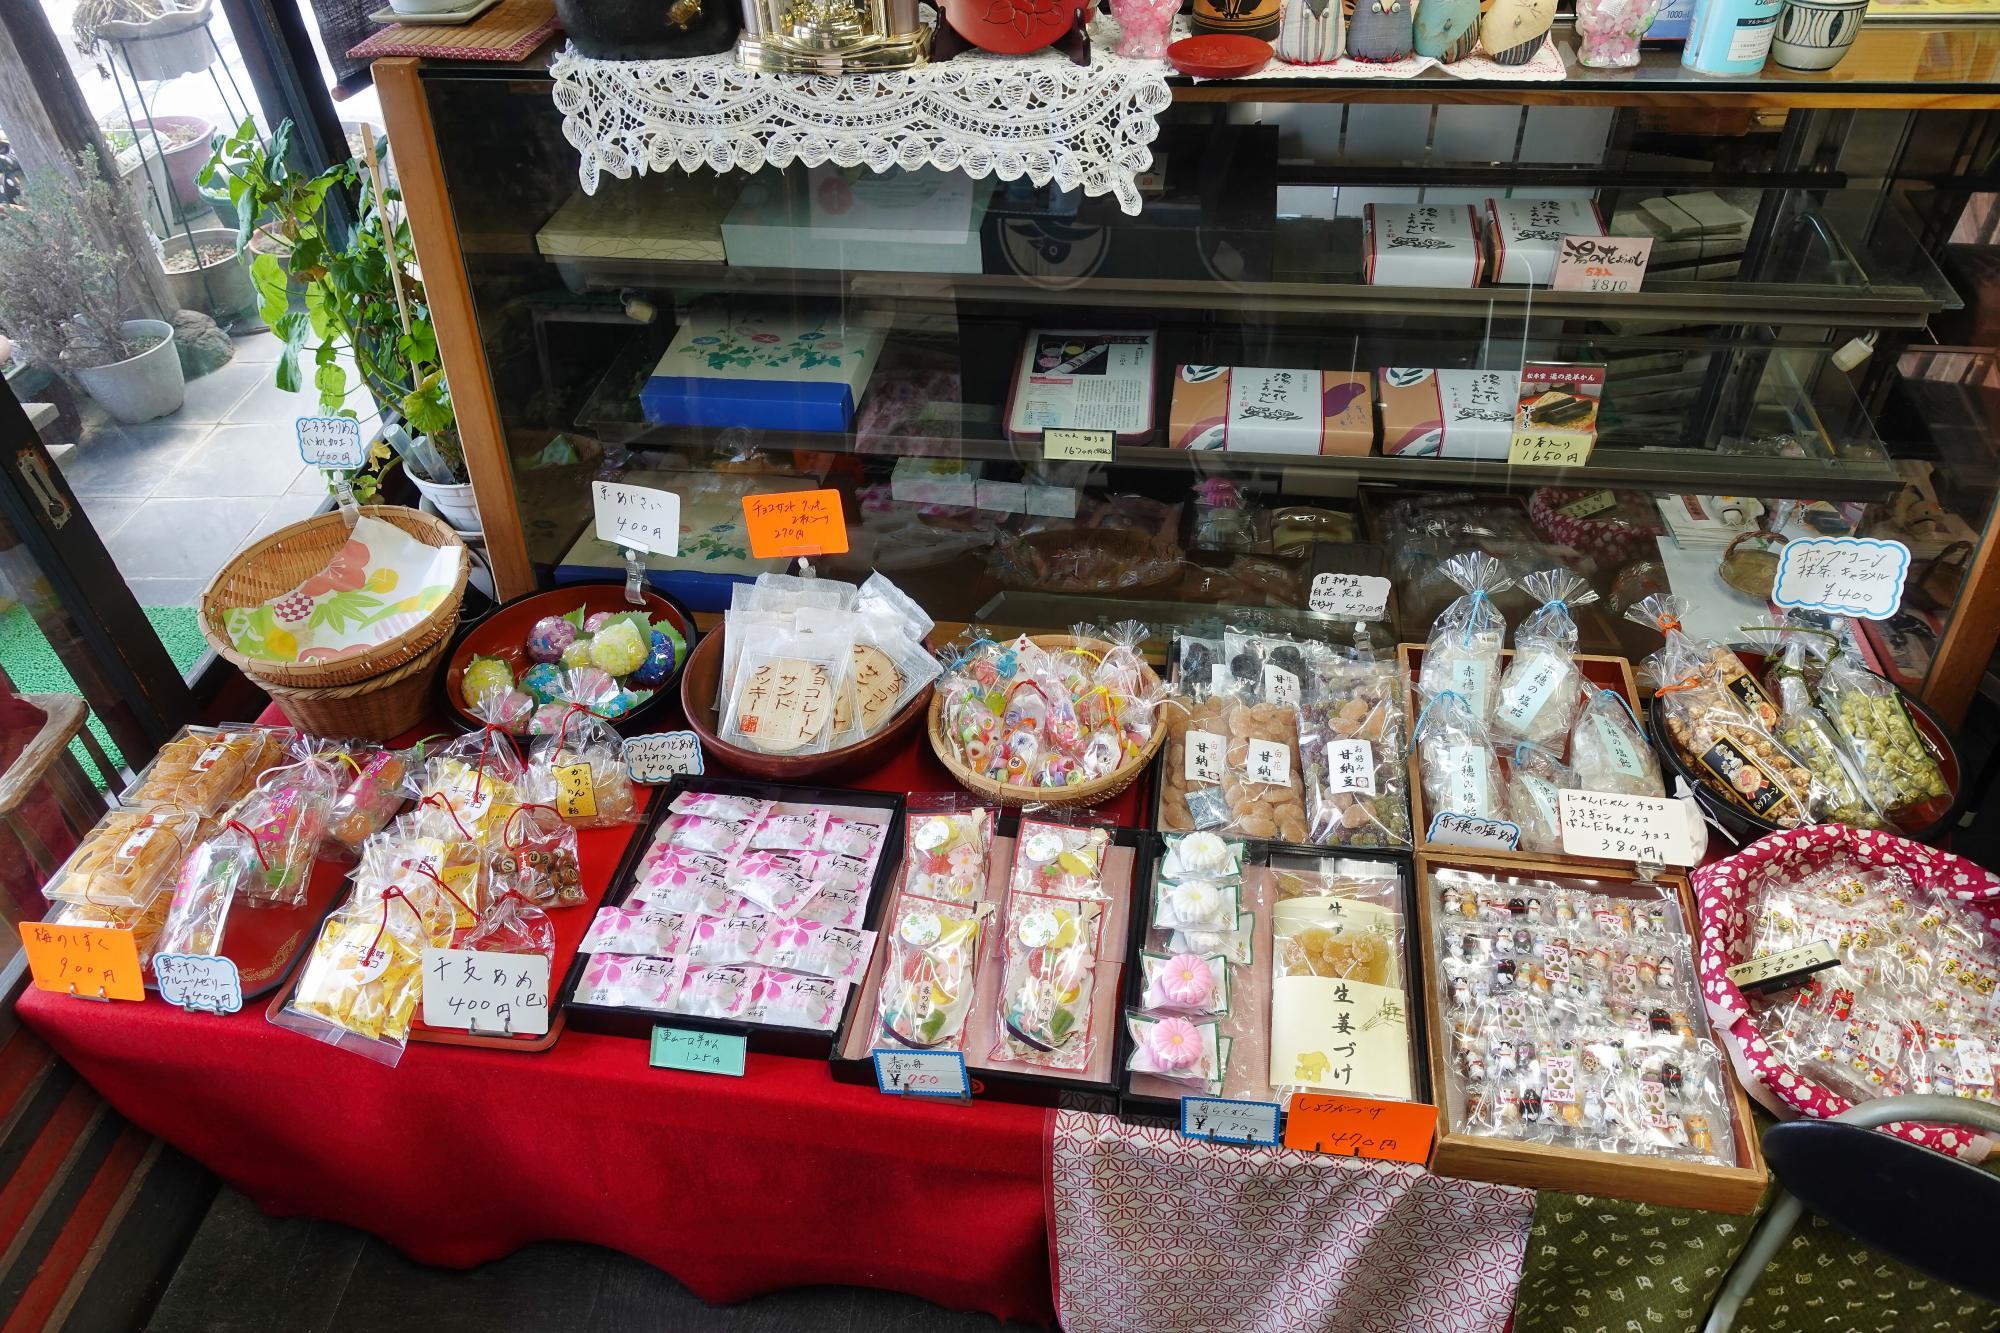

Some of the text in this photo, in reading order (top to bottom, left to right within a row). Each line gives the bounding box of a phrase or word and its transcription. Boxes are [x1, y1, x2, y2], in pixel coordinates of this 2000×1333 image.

[1591, 279, 1628, 292] ¥810
[1515, 437, 1570, 449] 10本入り
[316, 450, 350, 465] 400円
[1523, 451, 1578, 462] 1650円
[617, 516, 661, 539] 400円
[1797, 548, 1888, 568] ポップコーン
[1320, 575, 1362, 588] 甘納豆
[1820, 582, 1873, 603] ¥400
[1345, 603, 1383, 613] 470円
[748, 665, 771, 711] クッキー
[776, 675, 798, 709] サンド
[800, 664, 828, 738] チョコレート
[628, 737, 697, 753] かりんのどあめ
[1195, 742, 1209, 778] 甘納豆
[1355, 746, 1365, 772] お好み
[646, 763, 688, 774] 400円
[1339, 749, 1357, 788] 甘納豆
[571, 768, 585, 797] かりん
[1567, 794, 1664, 811] にゃんにゃん チョコ
[1622, 814, 1649, 823] チョコ
[1566, 818, 1670, 840] ぱんだちゃん チョコ
[1601, 839, 1655, 859] 380円
[1600, 916, 1621, 924] ニャン
[35, 927, 109, 952] 梅のしずく
[818, 928, 866, 953] 少年白虎
[1544, 947, 1568, 956] ニャン
[58, 957, 116, 983] 900円
[162, 958, 210, 976] 果汁入り
[433, 956, 532, 988] 干支あめ
[631, 960, 676, 978] 少年白虎
[1545, 970, 1569, 981] にゃん
[1761, 957, 1820, 978] 380円
[161, 975, 230, 989] フルーツゼリー
[701, 971, 748, 989] 少年白虎
[791, 979, 839, 1001] 少年白虎
[448, 997, 511, 1021] 400円
[1332, 982, 1356, 1085] 生姜づけ
[686, 1052, 720, 1065] 125円
[888, 1055, 924, 1070] 春の舟
[1548, 1059, 1572, 1068] ニャン
[1549, 1090, 1574, 1100] にゃん
[1299, 1098, 1386, 1120] しょうがづけ
[1645, 1115, 1667, 1126] ゃん
[1331, 1132, 1397, 1151] 470円
